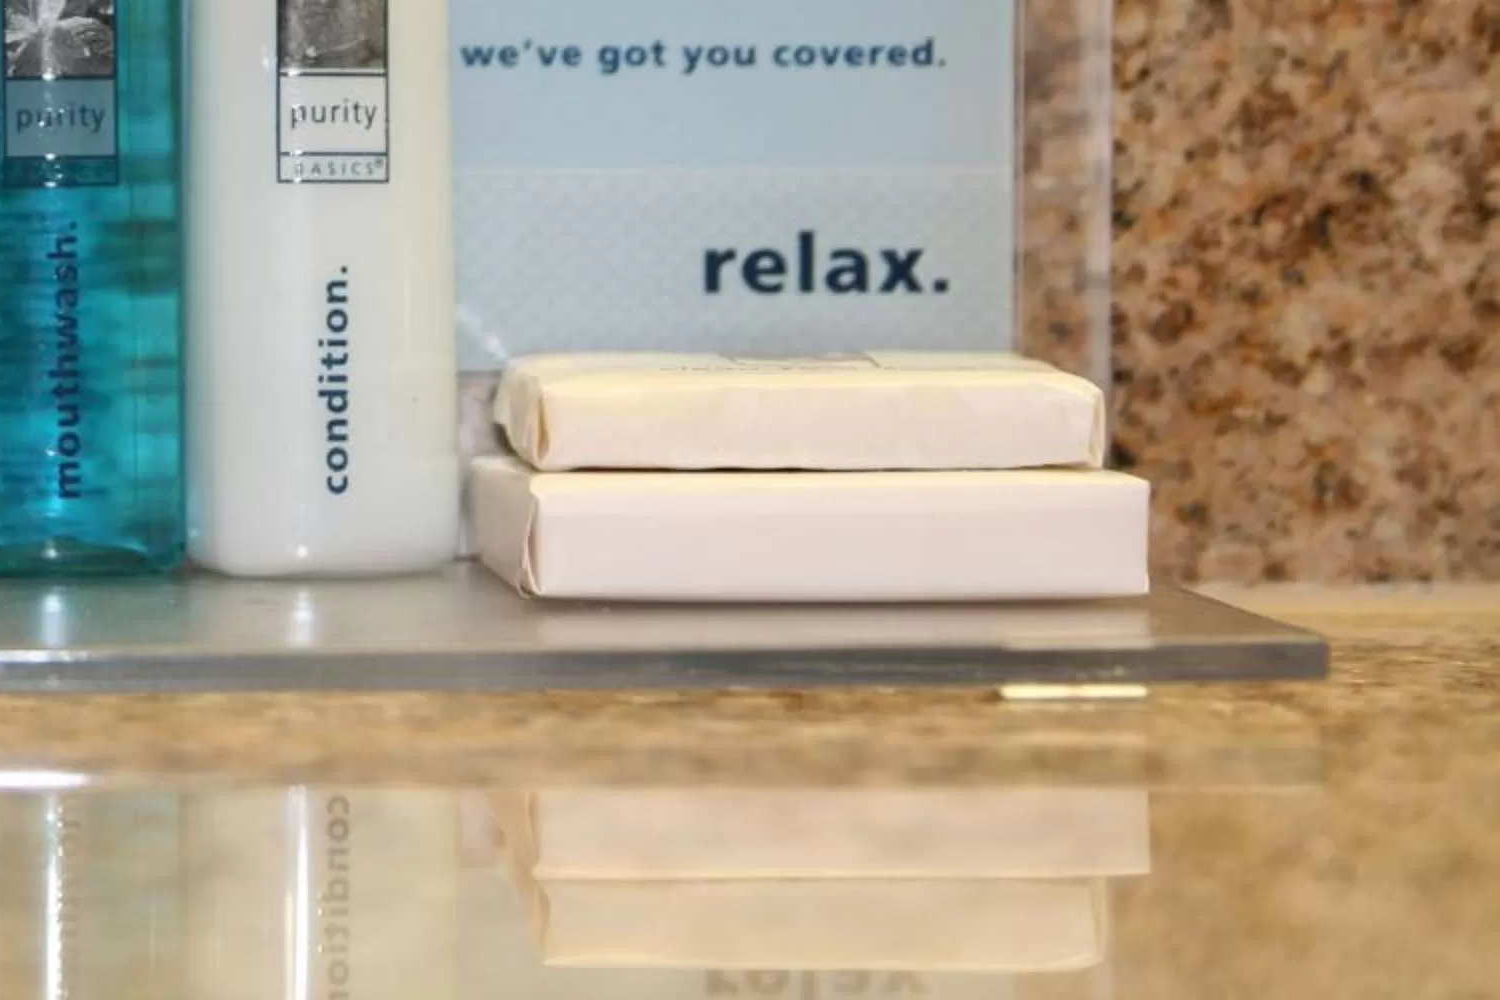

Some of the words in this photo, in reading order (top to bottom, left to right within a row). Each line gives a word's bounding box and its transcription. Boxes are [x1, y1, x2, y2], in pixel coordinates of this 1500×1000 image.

[460, 39, 583, 68] we've
[598, 40, 666, 76] got
[684, 45, 757, 76] you
[773, 37, 947, 69] covered.
[16, 103, 106, 134] purity
[291, 99, 378, 131] purity
[704, 229, 950, 295] relax.
[47, 219, 80, 499] mouthwash.
[318, 265, 349, 495] condition.
